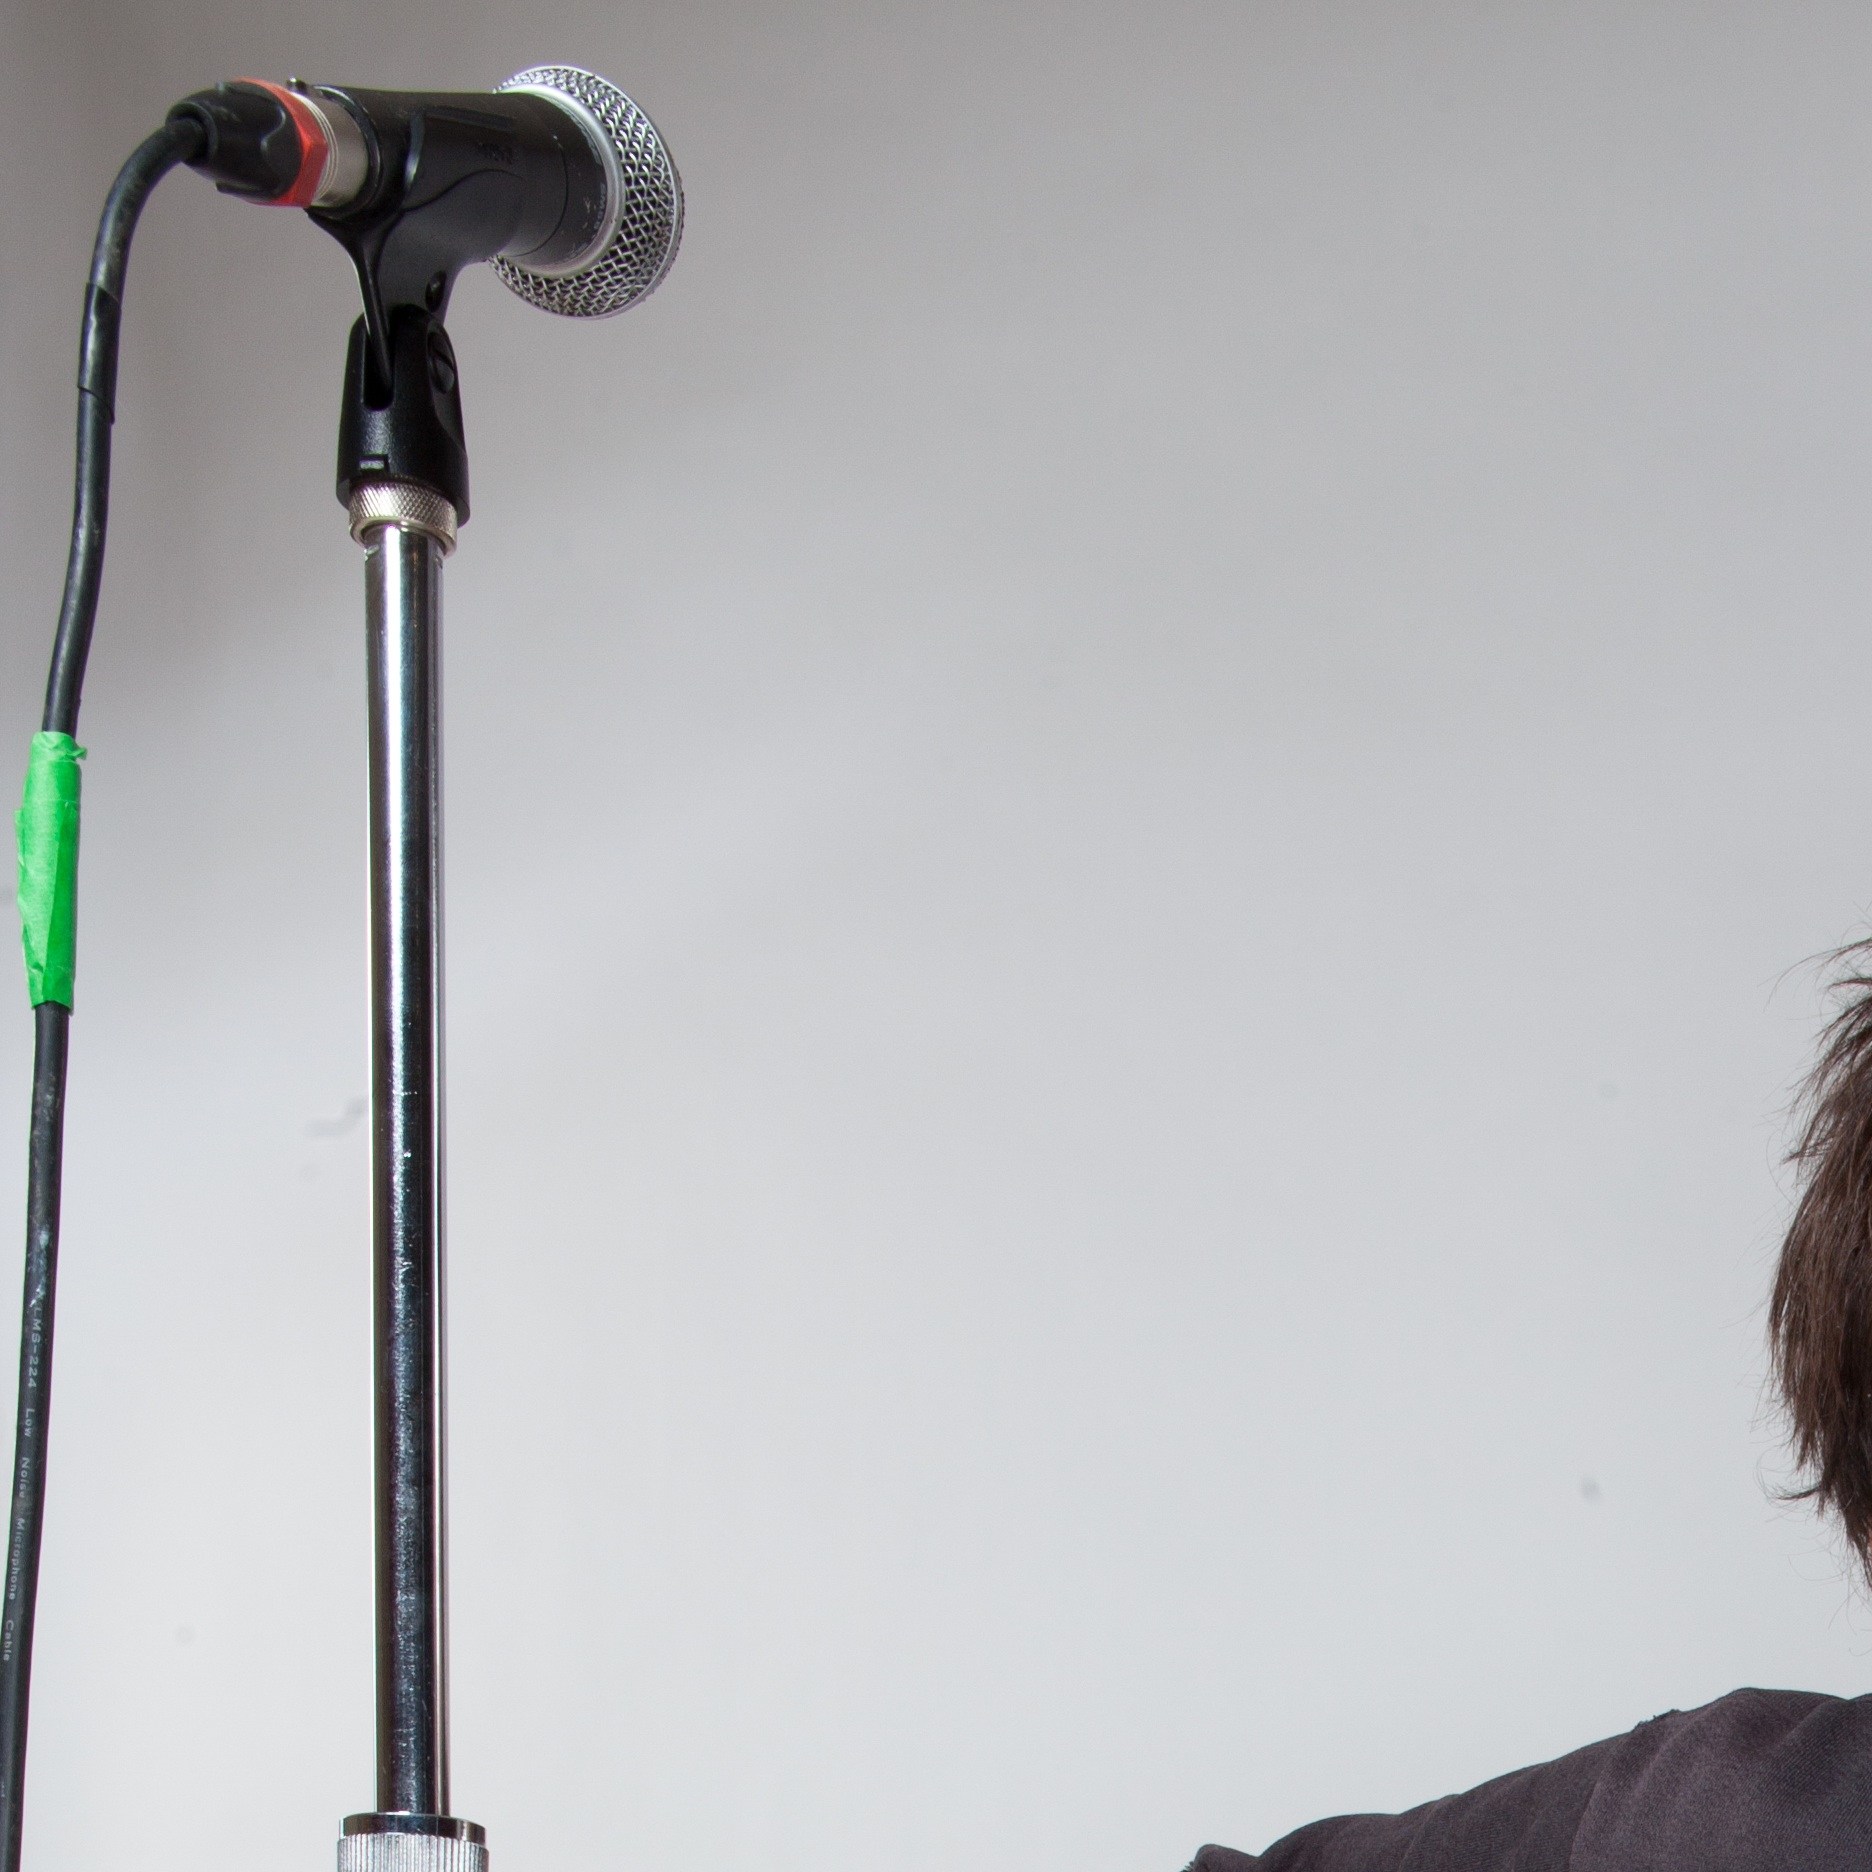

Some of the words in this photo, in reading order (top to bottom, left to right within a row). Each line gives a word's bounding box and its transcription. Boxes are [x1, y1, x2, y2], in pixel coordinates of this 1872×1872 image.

[24, 1408, 35, 1438] Low
[18, 1457, 30, 1499] Noise
[9, 1517, 26, 1600] Microphone
[3, 1619, 14, 1662] Cable
